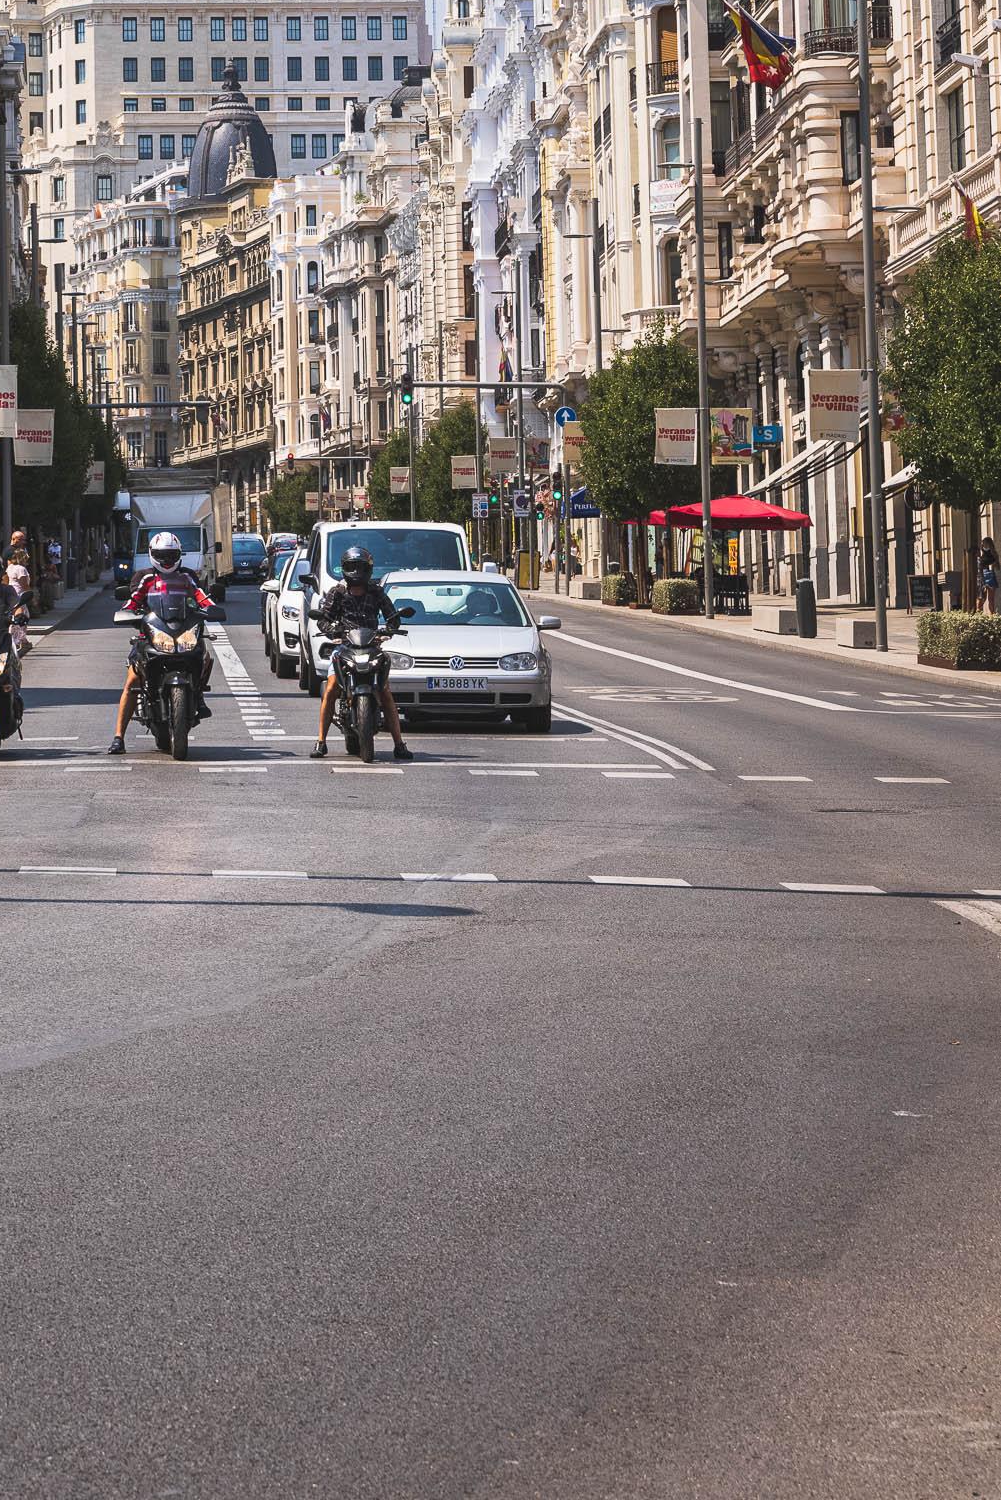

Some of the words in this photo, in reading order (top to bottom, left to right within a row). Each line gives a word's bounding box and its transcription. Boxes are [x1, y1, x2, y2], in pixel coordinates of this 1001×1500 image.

[812, 394, 860, 403] Veranos
[825, 402, 853, 412] Villa
[442, 678, 469, 688] 3888
[470, 678, 484, 688] YK
